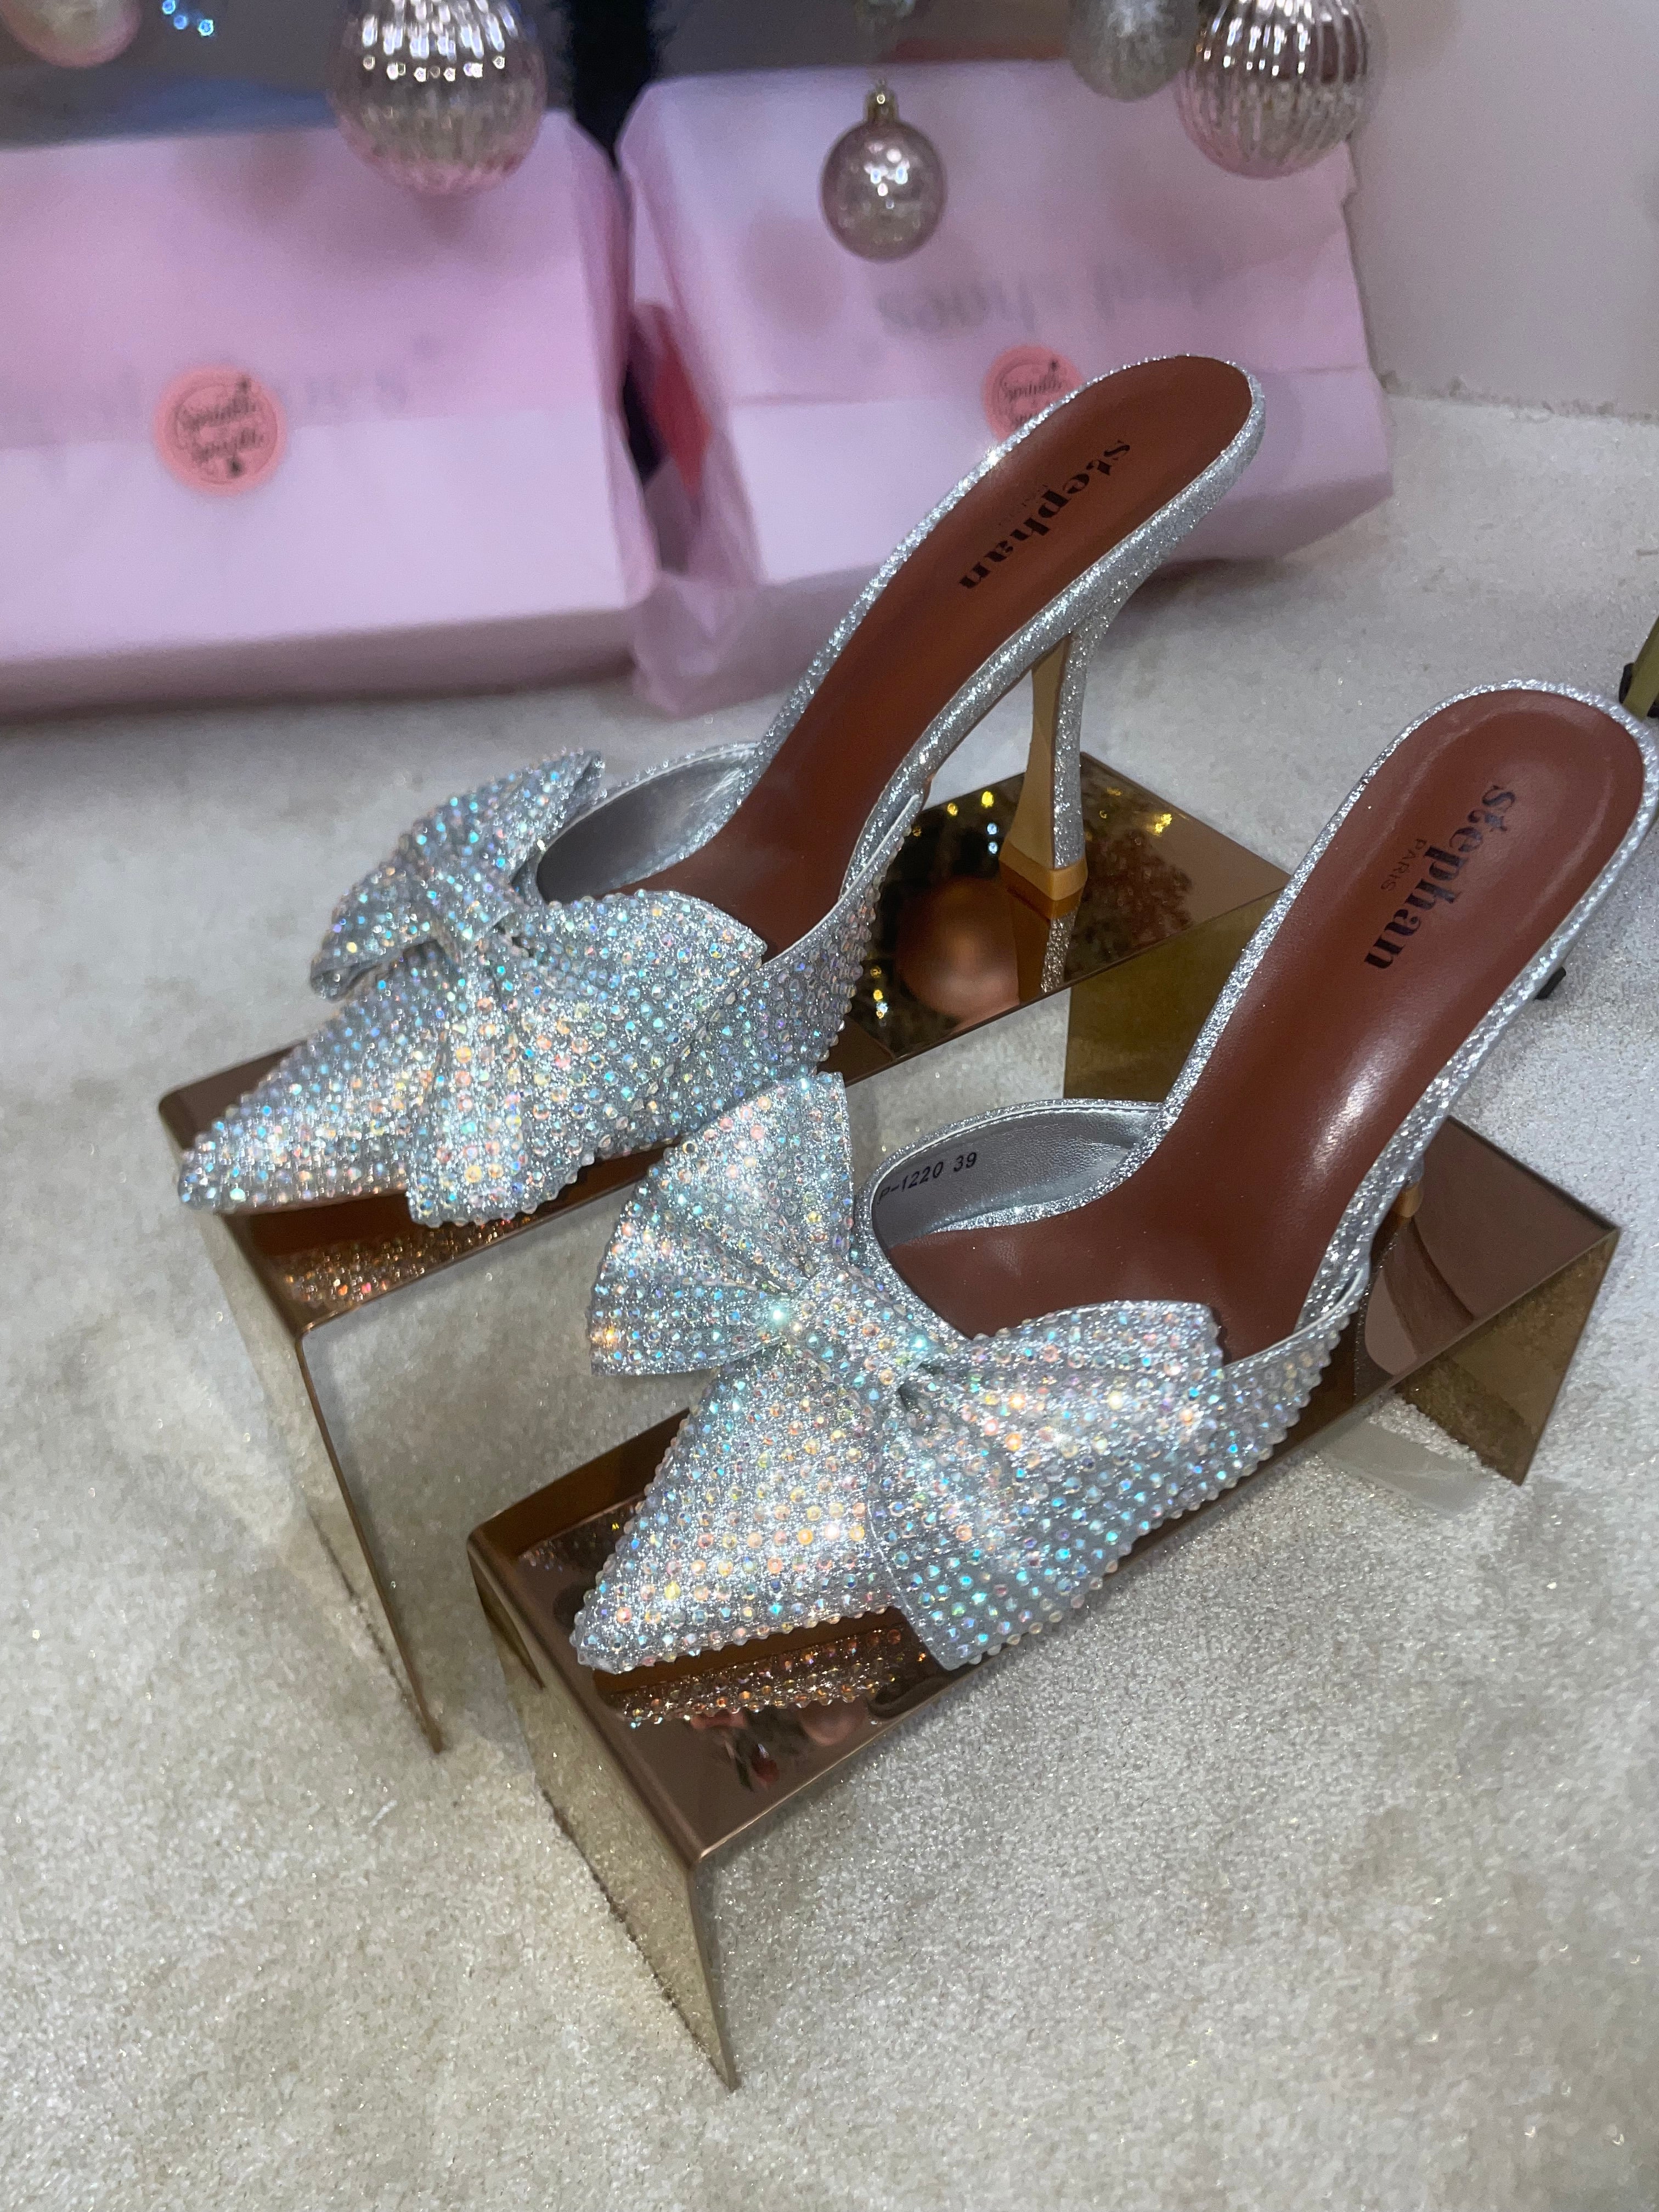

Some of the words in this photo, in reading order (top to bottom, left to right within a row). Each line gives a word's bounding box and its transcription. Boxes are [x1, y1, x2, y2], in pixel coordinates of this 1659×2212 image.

[958, 439, 1131, 590] stephan
[1363, 785, 1516, 969] stephan
[1380, 838, 1427, 891] PARIS
[953, 1152, 977, 1172] 39
